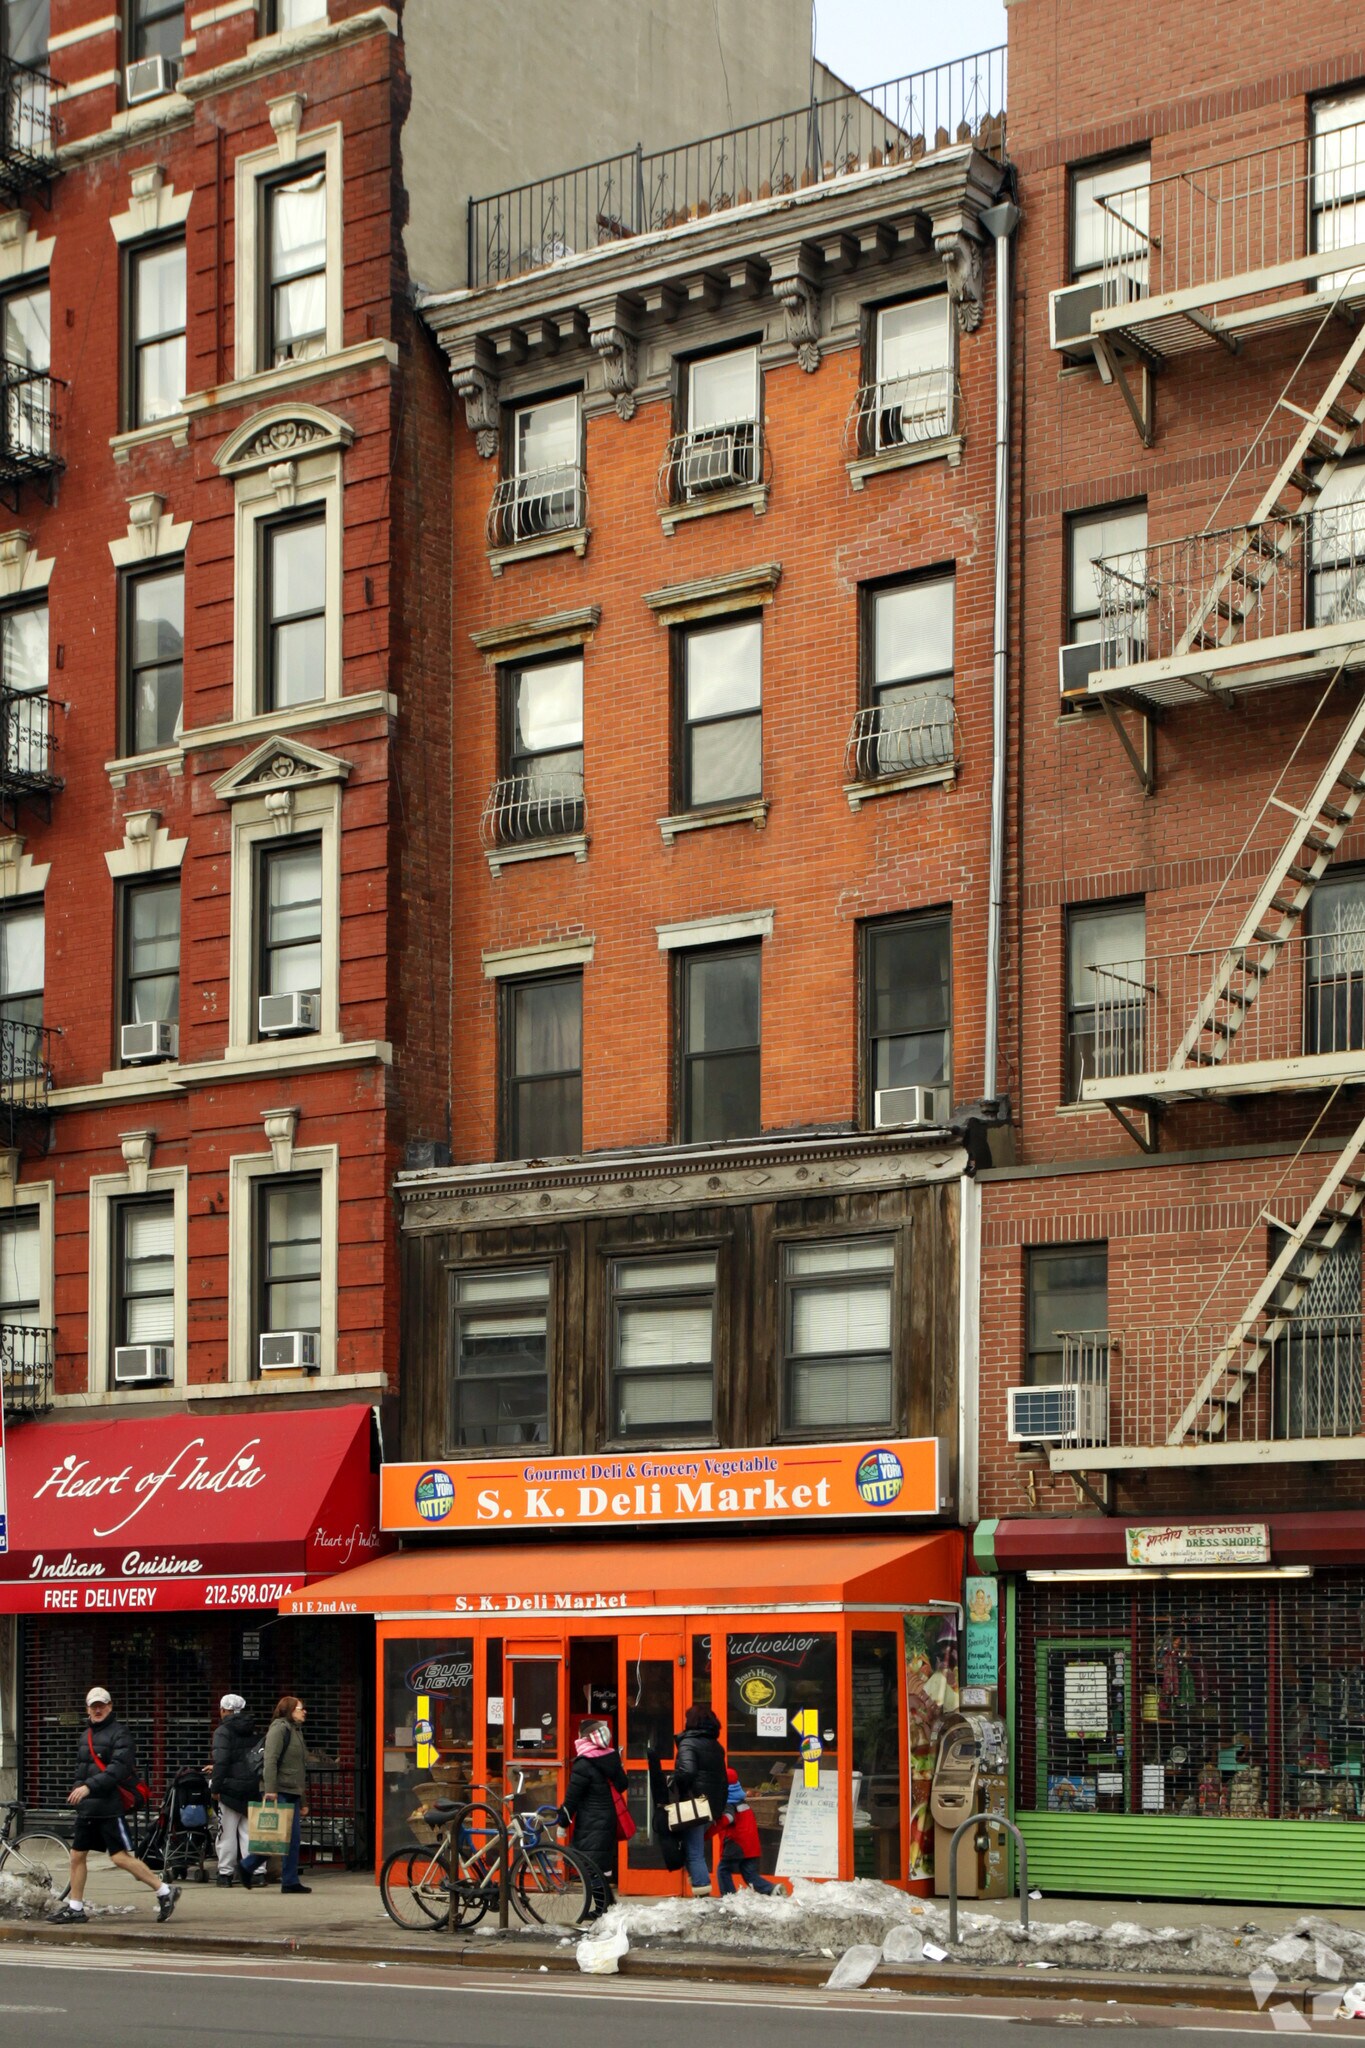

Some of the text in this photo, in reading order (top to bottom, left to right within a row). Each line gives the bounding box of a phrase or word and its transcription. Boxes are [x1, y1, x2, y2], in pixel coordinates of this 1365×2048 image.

[523, 1456, 779, 1482] Gourmet Deli & Grocery Vegetable
[33, 1438, 267, 1537] Heart of India
[477, 1477, 832, 1520] S. K. Deli Market
[313, 1527, 343, 1547] Heart
[339, 1523, 360, 1565] of
[1186, 1536, 1264, 1548] DRESS SHOPPE
[29, 1550, 203, 1579] Indian Cuisine
[44, 1589, 79, 1609] FREE
[85, 1587, 158, 1608] DELIVERY
[291, 1600, 357, 1613] 81 E 2nd Ave
[455, 1592, 628, 1612] S. K. Deli Market
[425, 1663, 473, 1678] BUD
[735, 1668, 778, 1686] Boar's Head
[413, 1674, 475, 1691] LIGHT
[760, 1716, 785, 1726] SOUP
